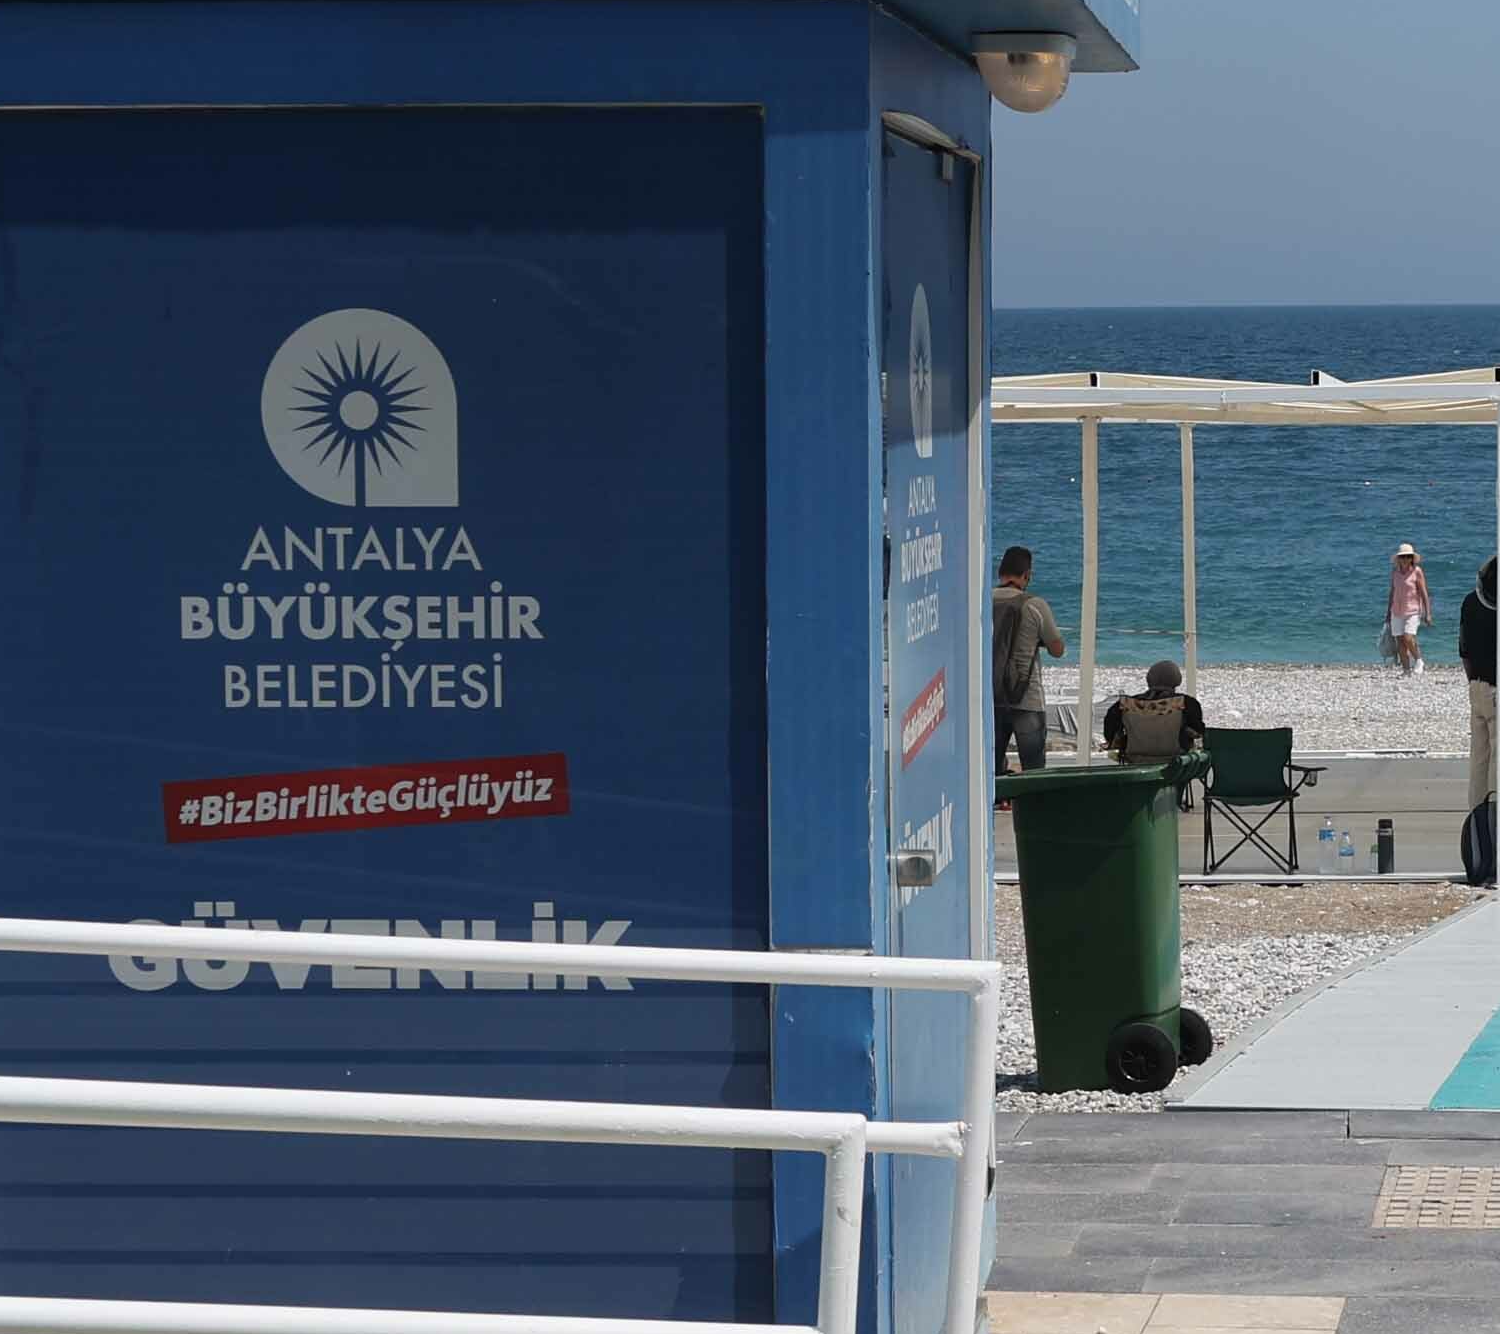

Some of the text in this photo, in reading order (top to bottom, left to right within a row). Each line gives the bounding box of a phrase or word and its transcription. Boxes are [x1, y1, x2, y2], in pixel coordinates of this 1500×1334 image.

[240, 525, 484, 573] ANTALYA
[179, 580, 544, 652] BÜYÜKŞEHİR
[223, 652, 504, 709] BELEDİYESİ
[178, 768, 554, 828] #BizBirlikteGüçlüyüz
